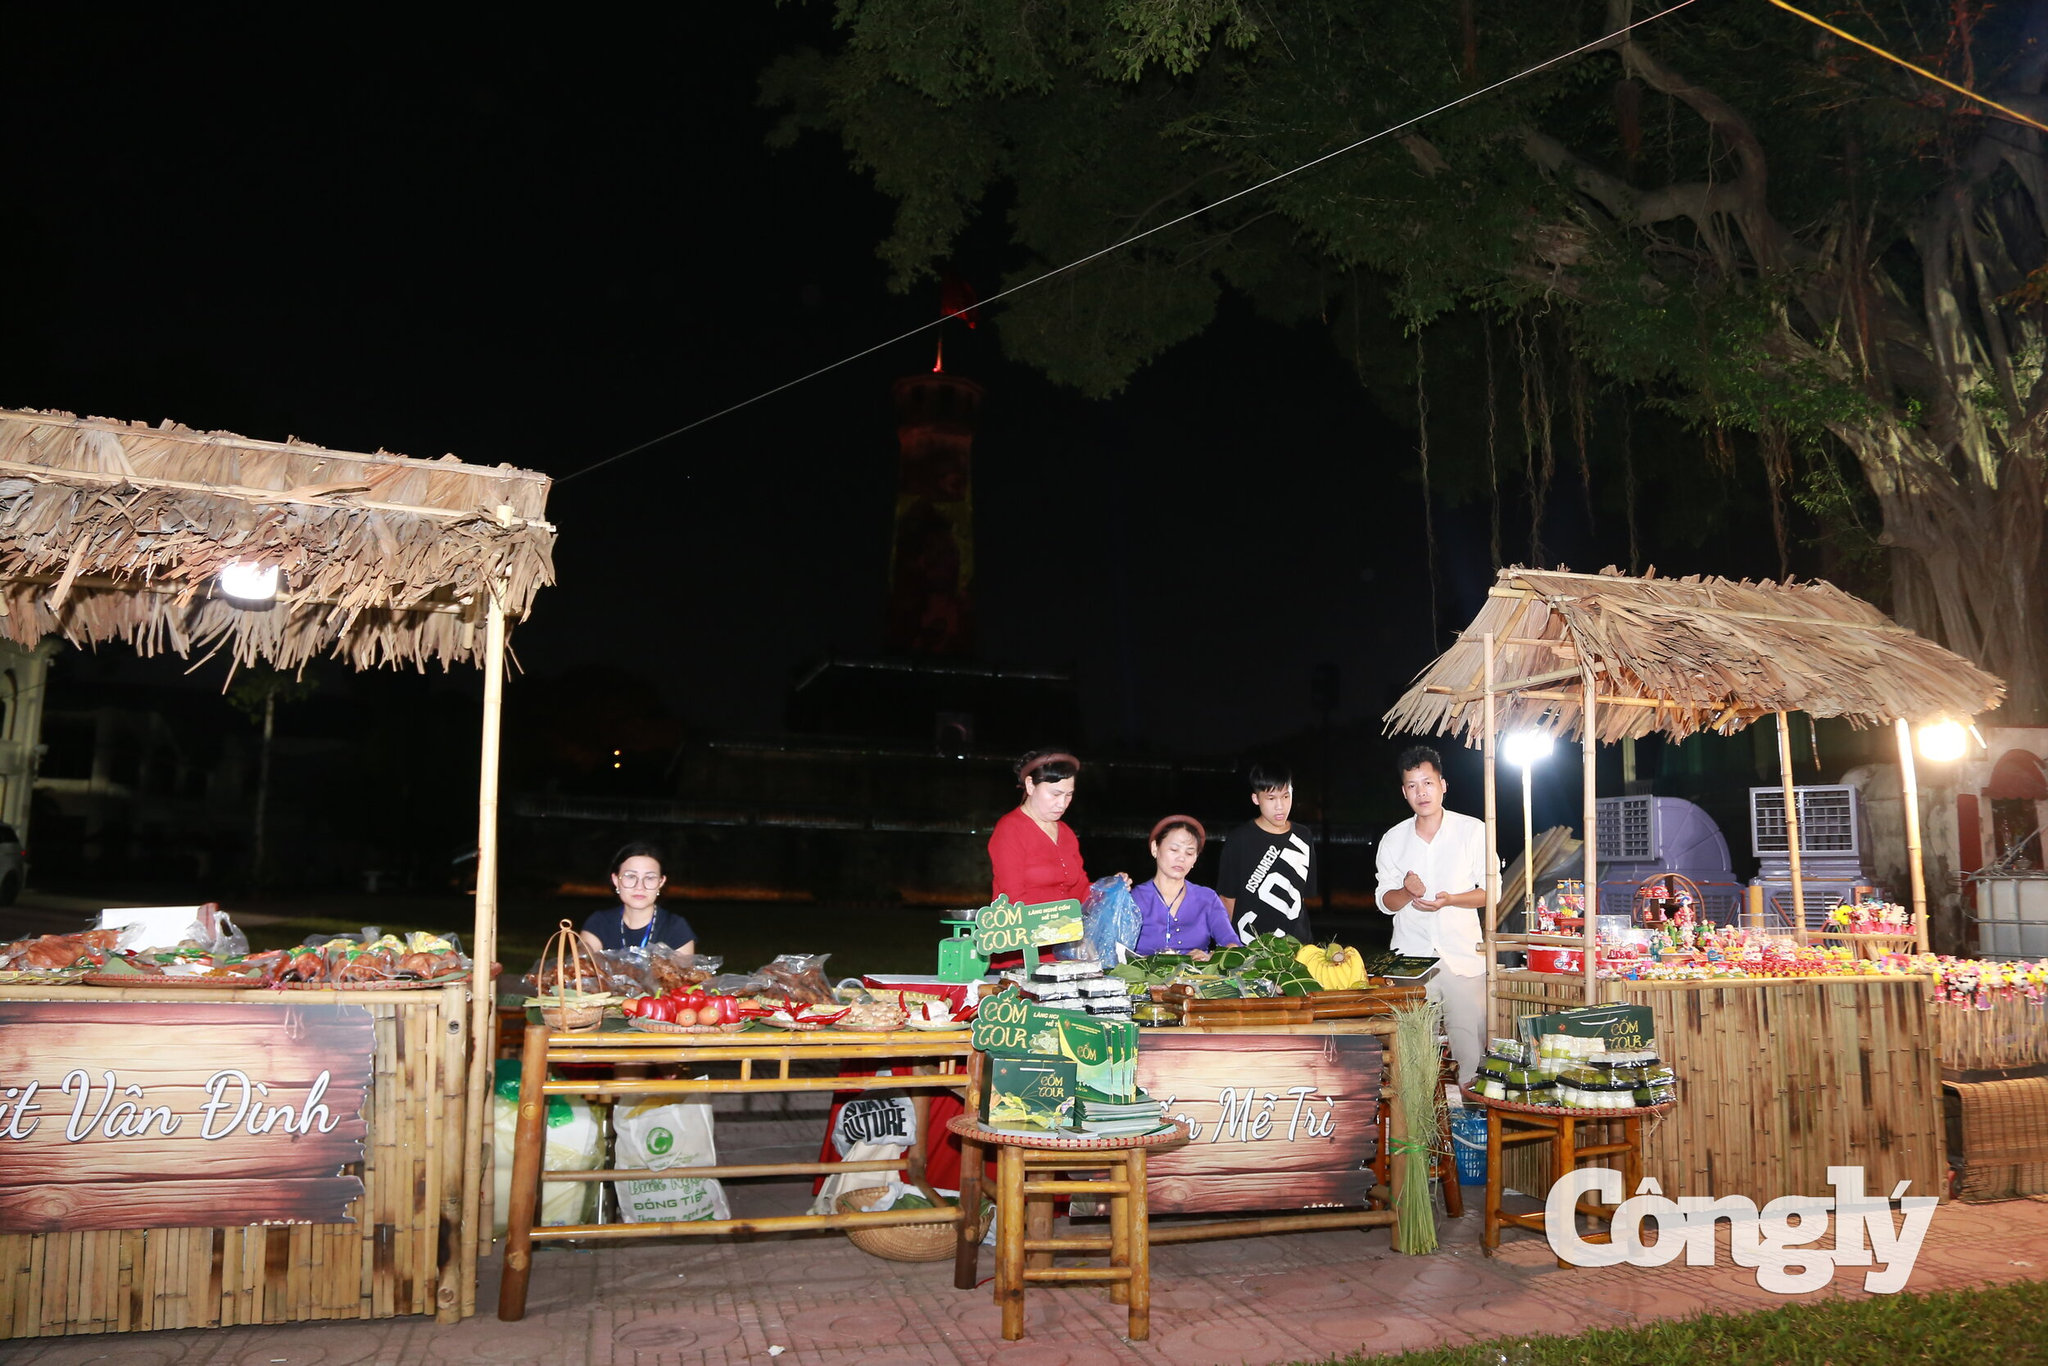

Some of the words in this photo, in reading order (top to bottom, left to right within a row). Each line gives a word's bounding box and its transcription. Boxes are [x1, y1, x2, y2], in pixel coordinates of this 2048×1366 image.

[1245, 845, 1281, 894] DSQUARED2
[979, 927, 1030, 951] TOUR
[984, 993, 1028, 1024] CỐM
[978, 1025, 1028, 1049] TOUR
[1611, 1016, 1639, 1035] CỐM
[1077, 1042, 1097, 1062] CỐM
[1608, 1035, 1643, 1049] TOUR
[1040, 1072, 1063, 1087] CỐM
[1038, 1087, 1065, 1098] TOUR
[61, 1068, 183, 1143] Vân
[199, 1068, 342, 1141] Đình
[1211, 1086, 1273, 1143] Mễ
[1286, 1086, 1337, 1142] Trì
